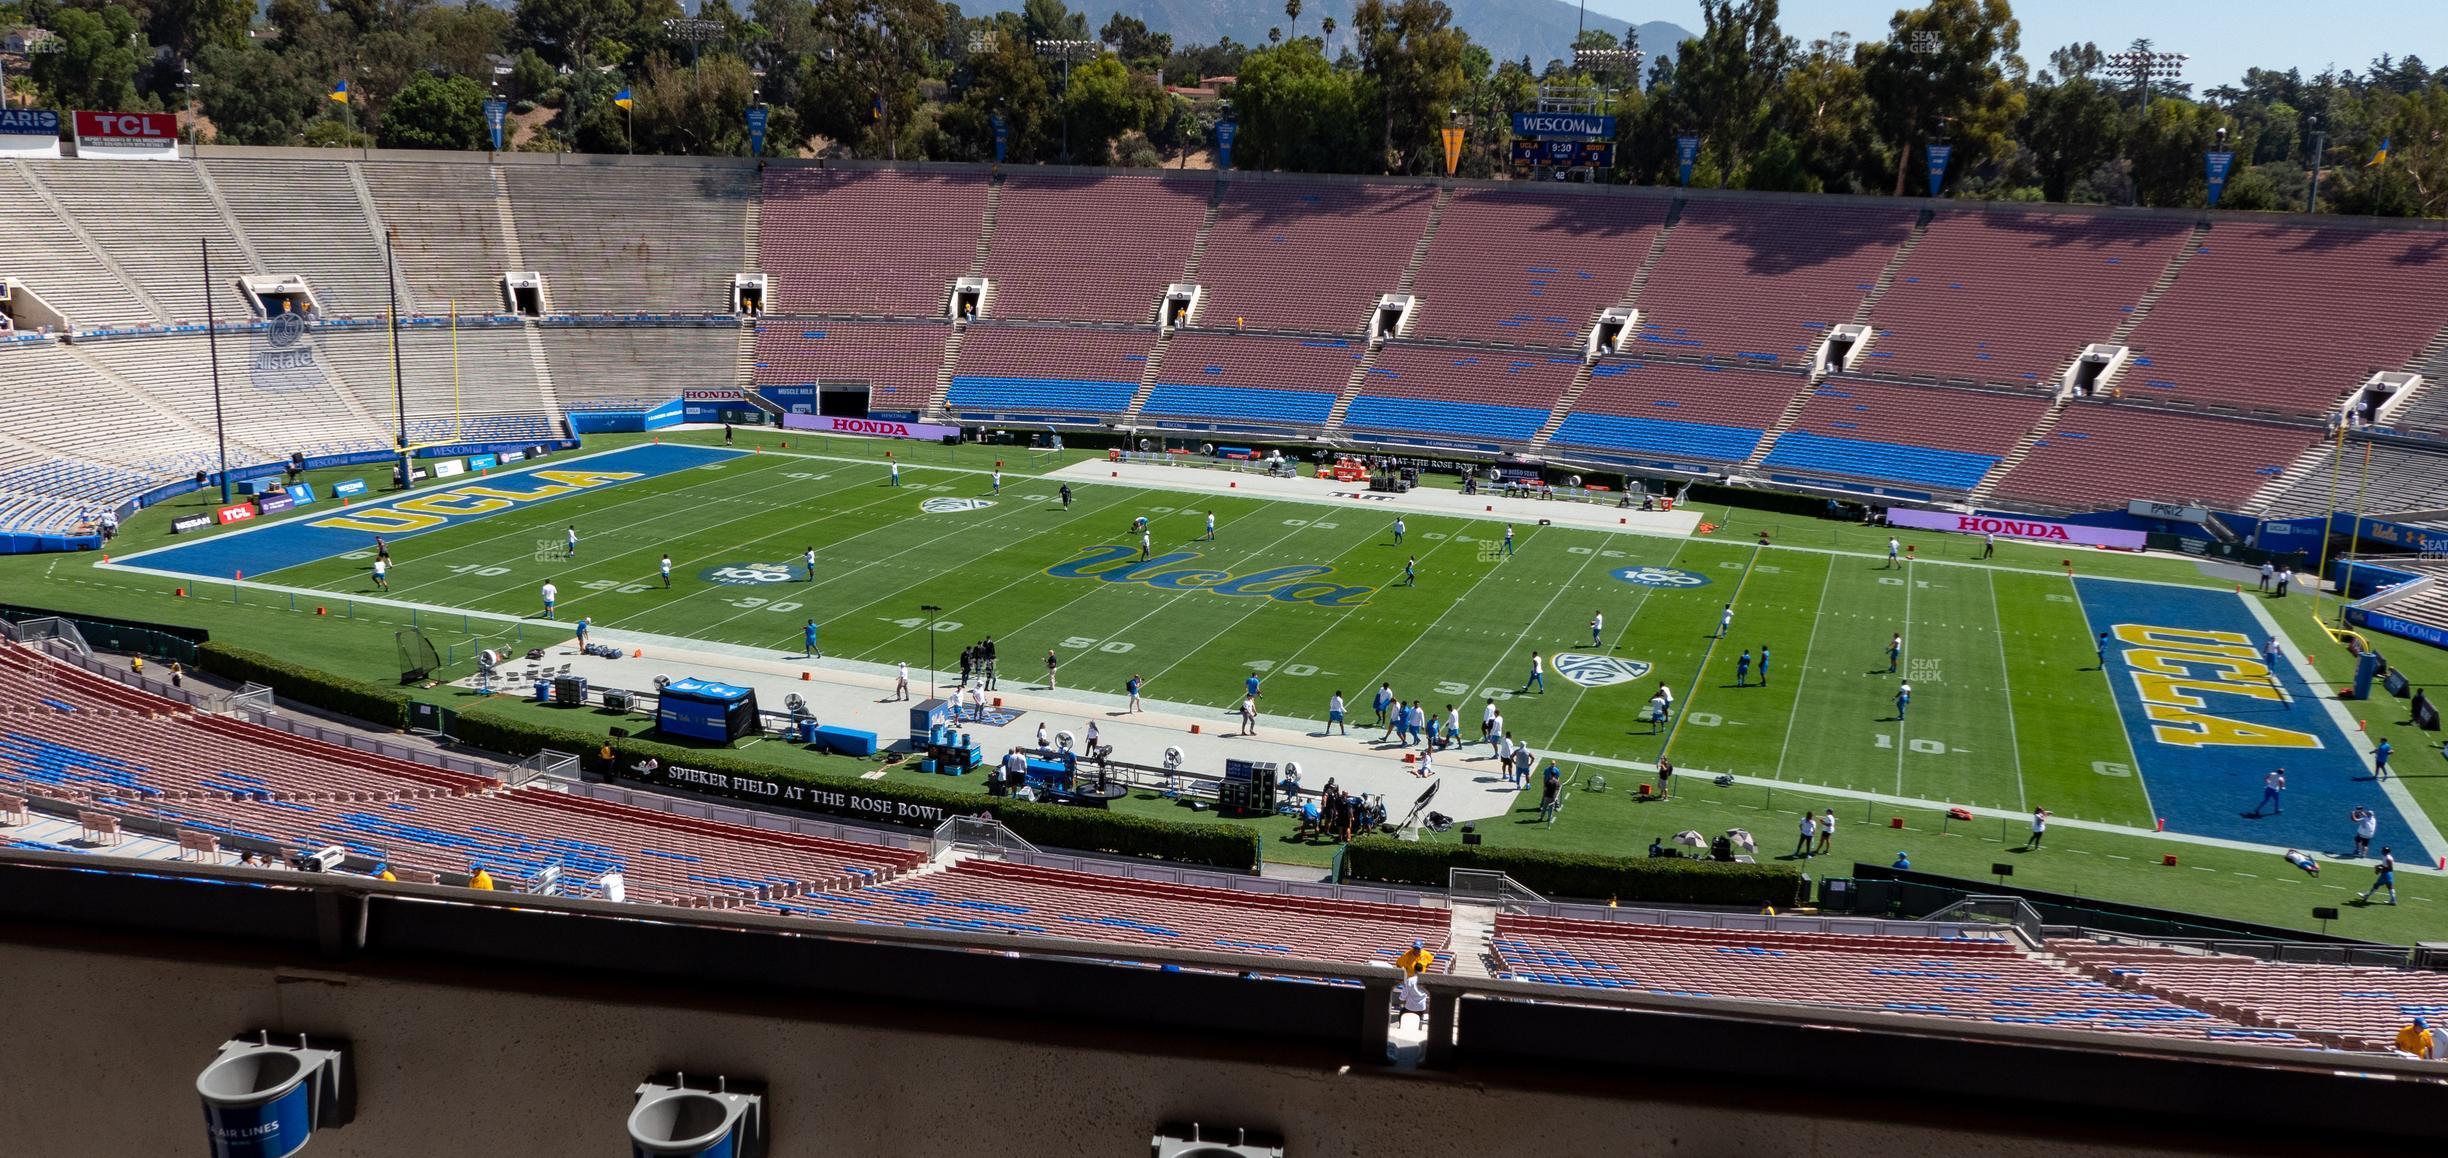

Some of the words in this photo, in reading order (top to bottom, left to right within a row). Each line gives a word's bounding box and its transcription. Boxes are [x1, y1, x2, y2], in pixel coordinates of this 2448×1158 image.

[95, 115, 161, 135] TCL
[1523, 117, 1585, 131] WESCOM
[1525, 150, 1531, 158] 0
[1552, 144, 1572, 153] 9:30
[1592, 152, 1599, 161] 0
[685, 390, 742, 399] HONDA
[833, 419, 910, 436] HONDA
[433, 446, 472, 456] WESCOM
[1431, 459, 1453, 469] ROSE
[304, 459, 646, 533] UCLA
[222, 506, 251, 522] TCL
[175, 517, 211, 531] NISSAN
[1958, 516, 2070, 540] HONDA
[711, 567, 792, 583] 100
[711, 576, 759, 586] YEARS
[1041, 545, 1378, 608] Ucla
[1624, 570, 1703, 586] 100
[2384, 617, 2430, 639] WESCOM
[2111, 623, 2326, 749] UCLA
[668, 765, 728, 788] SPIEKER
[733, 776, 779, 798] FIELD
[784, 785, 805, 801] AT
[810, 789, 846, 808] THE
[850, 794, 893, 816] ROSE
[897, 802, 946, 823] BOWL
[218, 1129, 238, 1138] AIR
[241, 1120, 280, 1137] LINES
